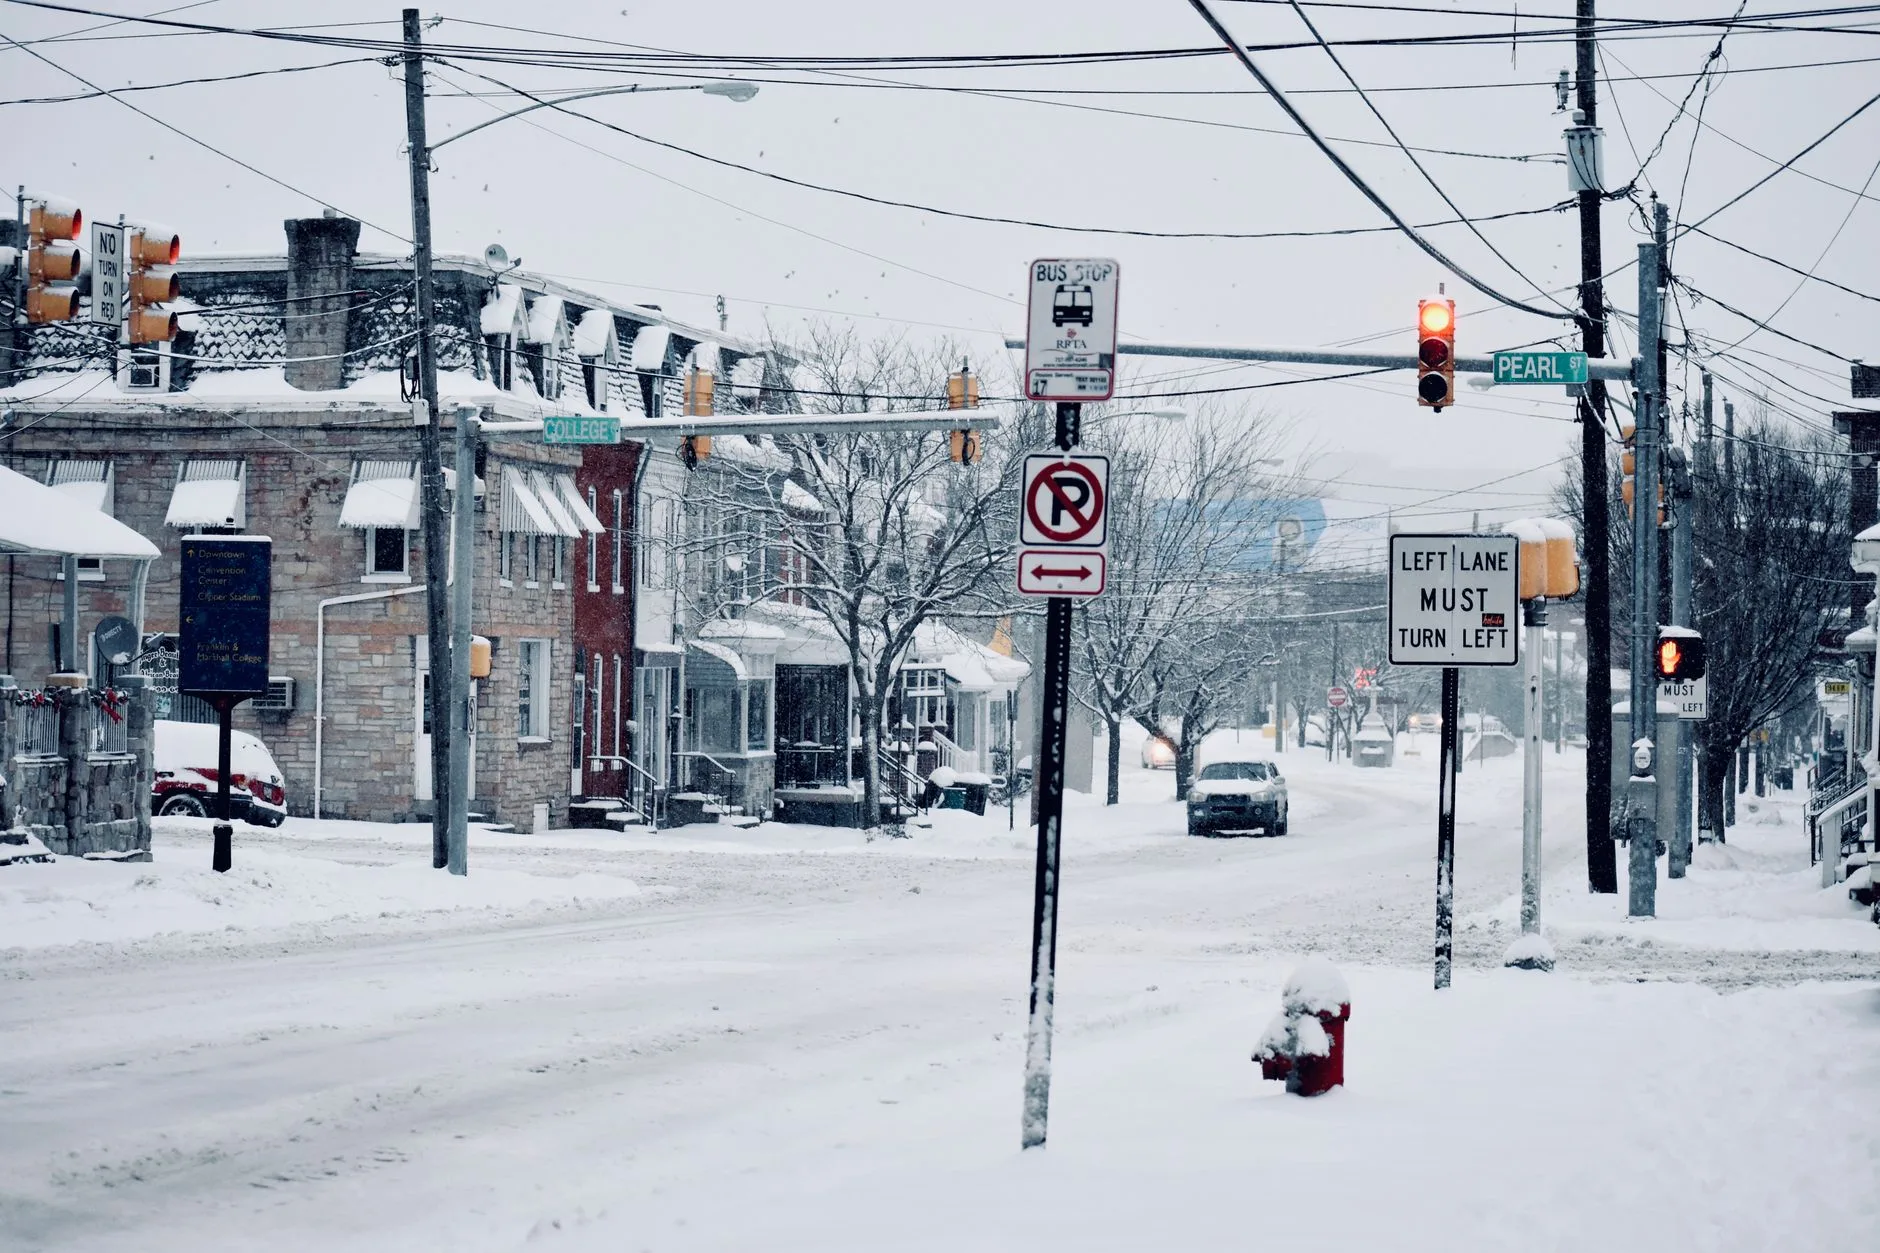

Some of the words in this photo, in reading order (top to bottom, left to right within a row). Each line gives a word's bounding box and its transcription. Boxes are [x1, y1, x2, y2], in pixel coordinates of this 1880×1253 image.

[100, 232, 116, 255] NO
[99, 260, 117, 277] TURN
[1037, 265, 1067, 282] BUS
[103, 281, 114, 297] ON
[101, 302, 115, 319] RED
[1499, 356, 1563, 379] PEARL
[1569, 356, 1583, 369] ST
[545, 420, 609, 440] COLLEGE
[199, 550, 245, 559] Downtown
[1402, 552, 1447, 571] LEFT
[1460, 552, 1508, 571] LANE
[198, 566, 246, 576] Convention
[229, 592, 261, 602] Stadium
[1421, 588, 1488, 612] MUST
[232, 642, 239, 652] &
[1399, 628, 1446, 648] TURN
[1463, 628, 1508, 649] LEFT
[232, 653, 262, 664] College
[1664, 685, 1695, 696] MUST
[1682, 703, 1703, 713] LEFT
